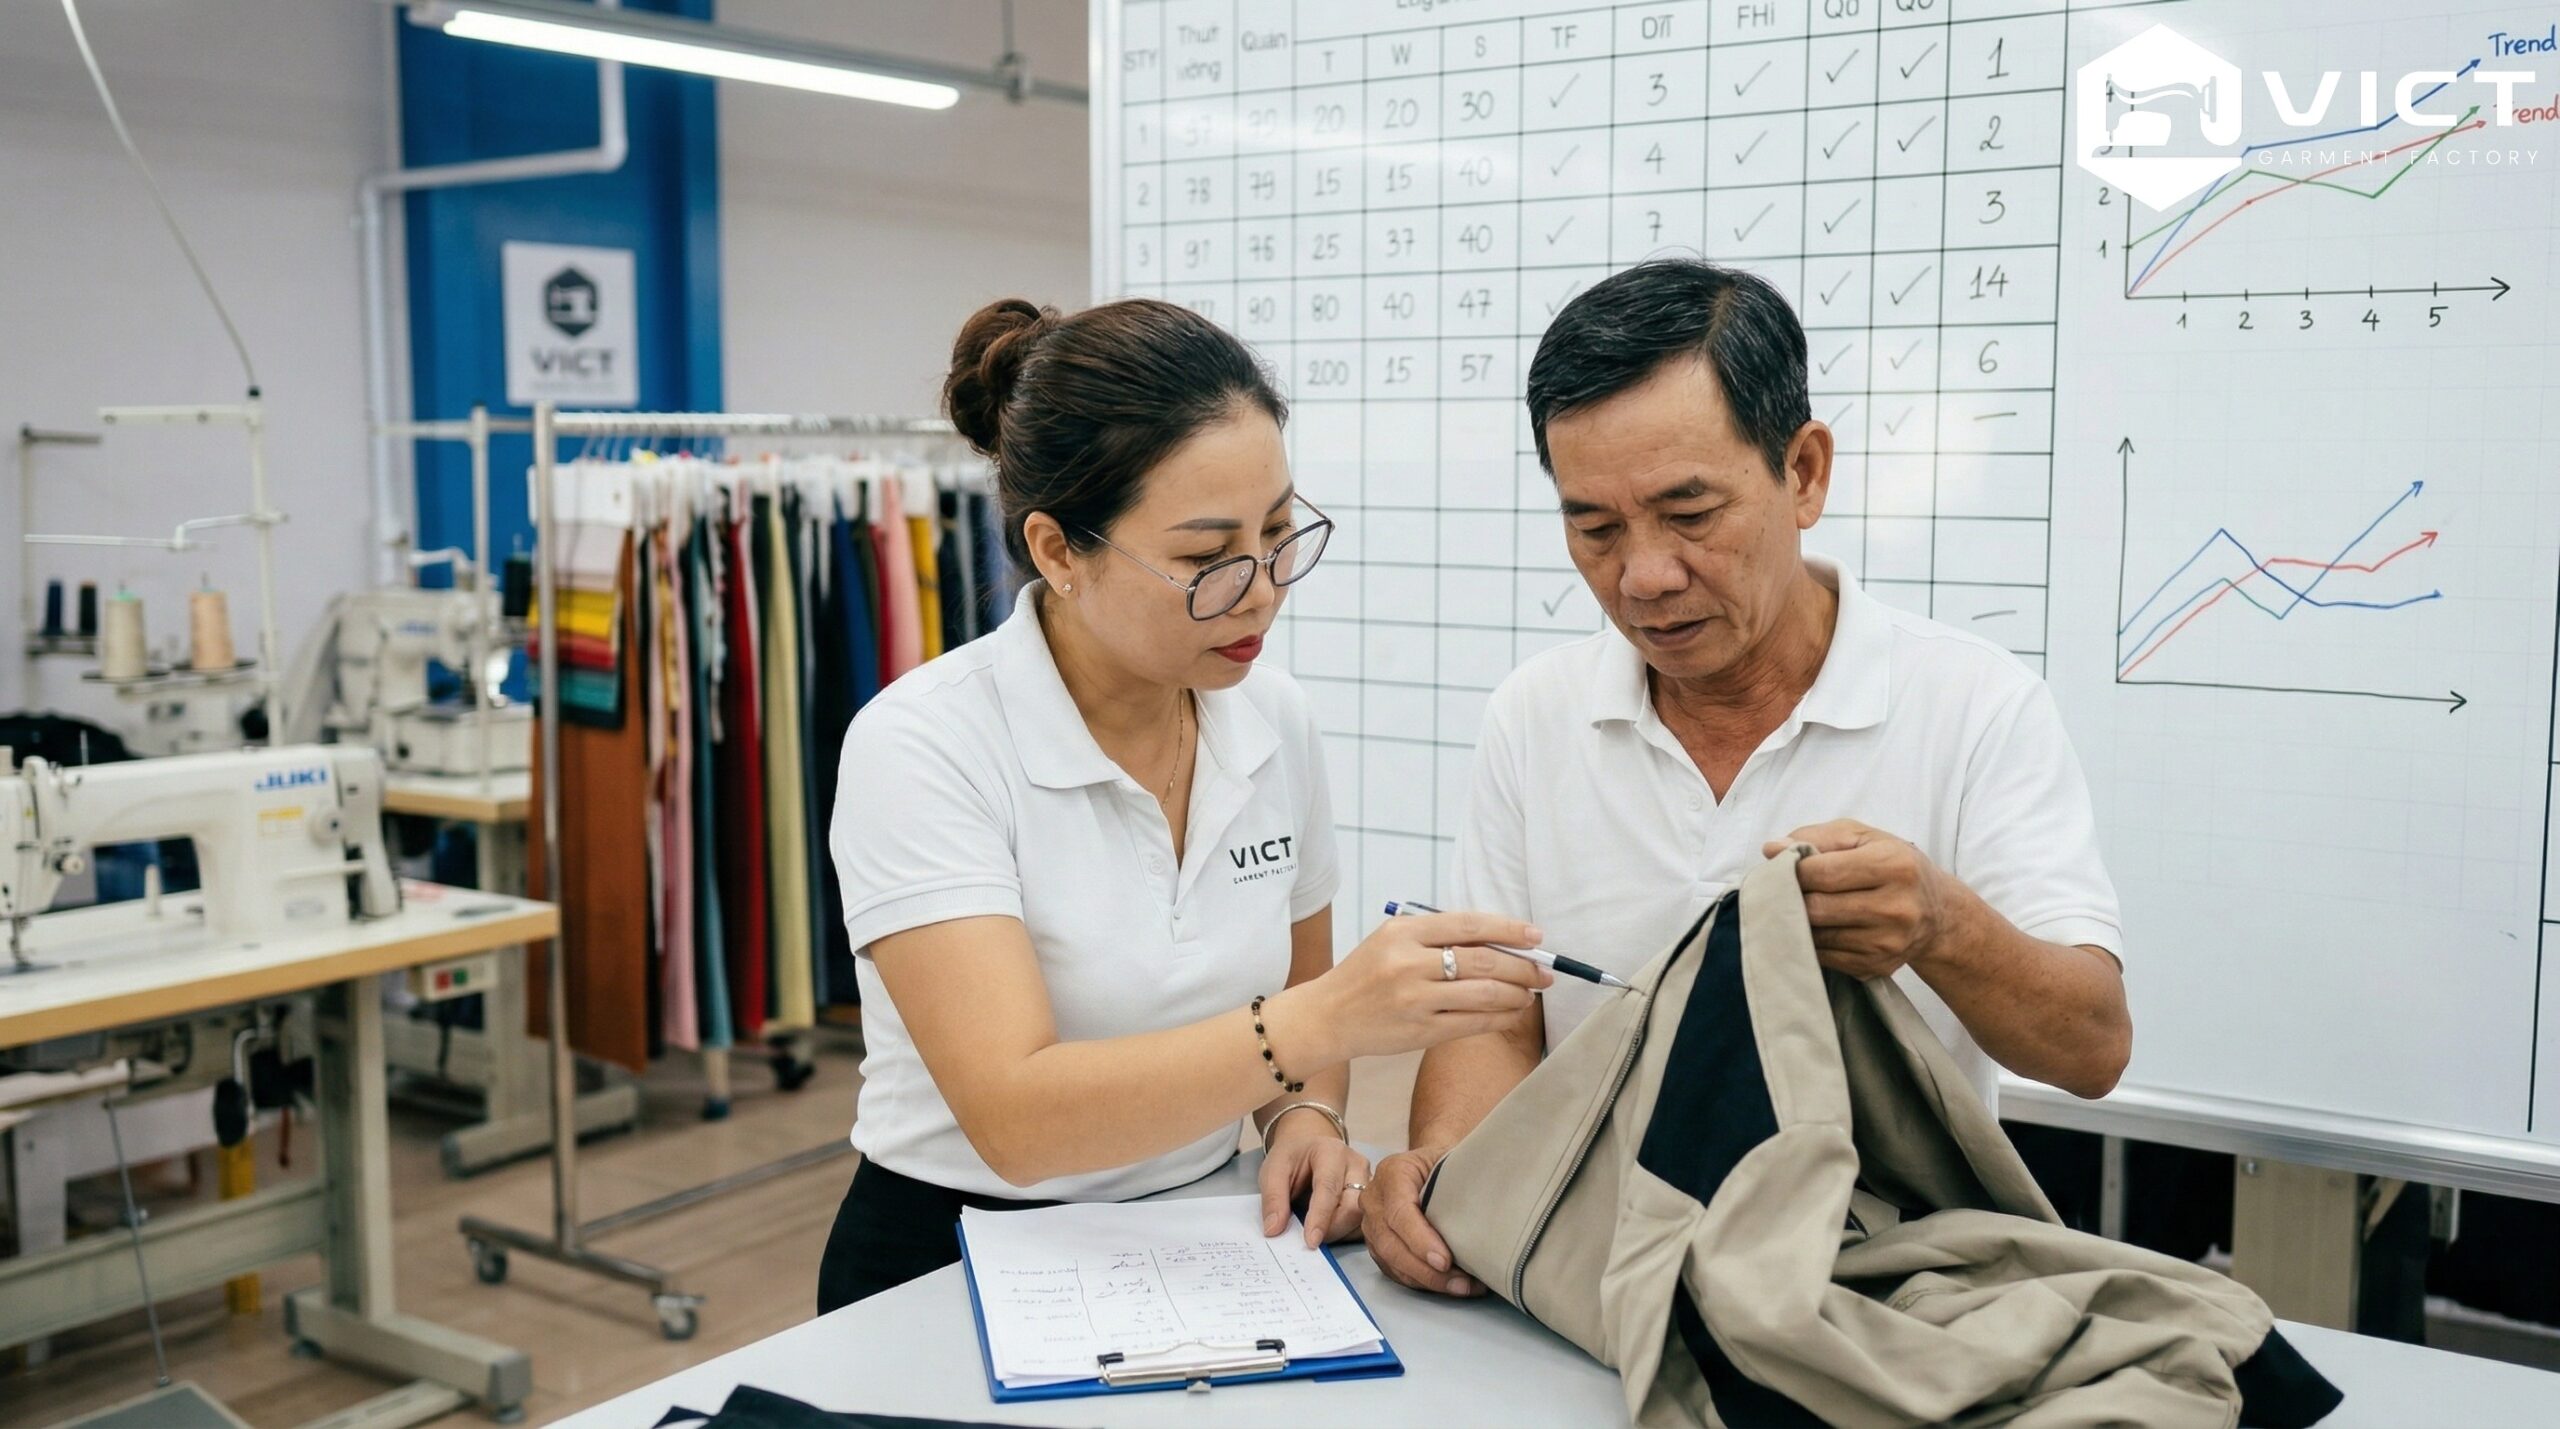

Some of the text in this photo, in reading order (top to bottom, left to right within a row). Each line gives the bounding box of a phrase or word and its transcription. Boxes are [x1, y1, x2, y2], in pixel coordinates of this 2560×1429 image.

[1551, 25, 1577, 49] TF
[2487, 24, 2558, 58] Trend
[1322, 51, 1335, 72] T
[1391, 42, 1412, 66] W
[1314, 104, 1346, 134] 20
[1384, 98, 1420, 129] 20
[1460, 90, 1494, 122] 30
[1647, 73, 1668, 106] 3
[1987, 37, 2010, 80] 1
[2493, 93, 2560, 125] rend
[1137, 181, 1151, 206] 2
[1314, 167, 1342, 196] 15
[1385, 163, 1416, 192] 15
[1458, 156, 1494, 187] 40
[1645, 142, 1665, 175] 4
[1979, 115, 2005, 152] 2
[2098, 187, 2111, 206] 2
[1137, 242, 1150, 267] 3
[1312, 233, 1341, 260] 25
[1385, 227, 1415, 258] 37
[1458, 224, 1494, 254] 40
[1646, 210, 1662, 242] 7
[1978, 190, 2006, 225] 3
[2096, 240, 2107, 259] 1
[1383, 291, 1416, 320] 40
[1458, 289, 1493, 319] 47
[1969, 264, 2009, 300] 14
[2176, 306, 2449, 332] 1 2 3 4 5
[530, 347, 614, 377] VICT
[1307, 340, 1999, 386] 200 15 57 6
[254, 767, 328, 792] JUKI
[1229, 836, 1292, 869] VICT
